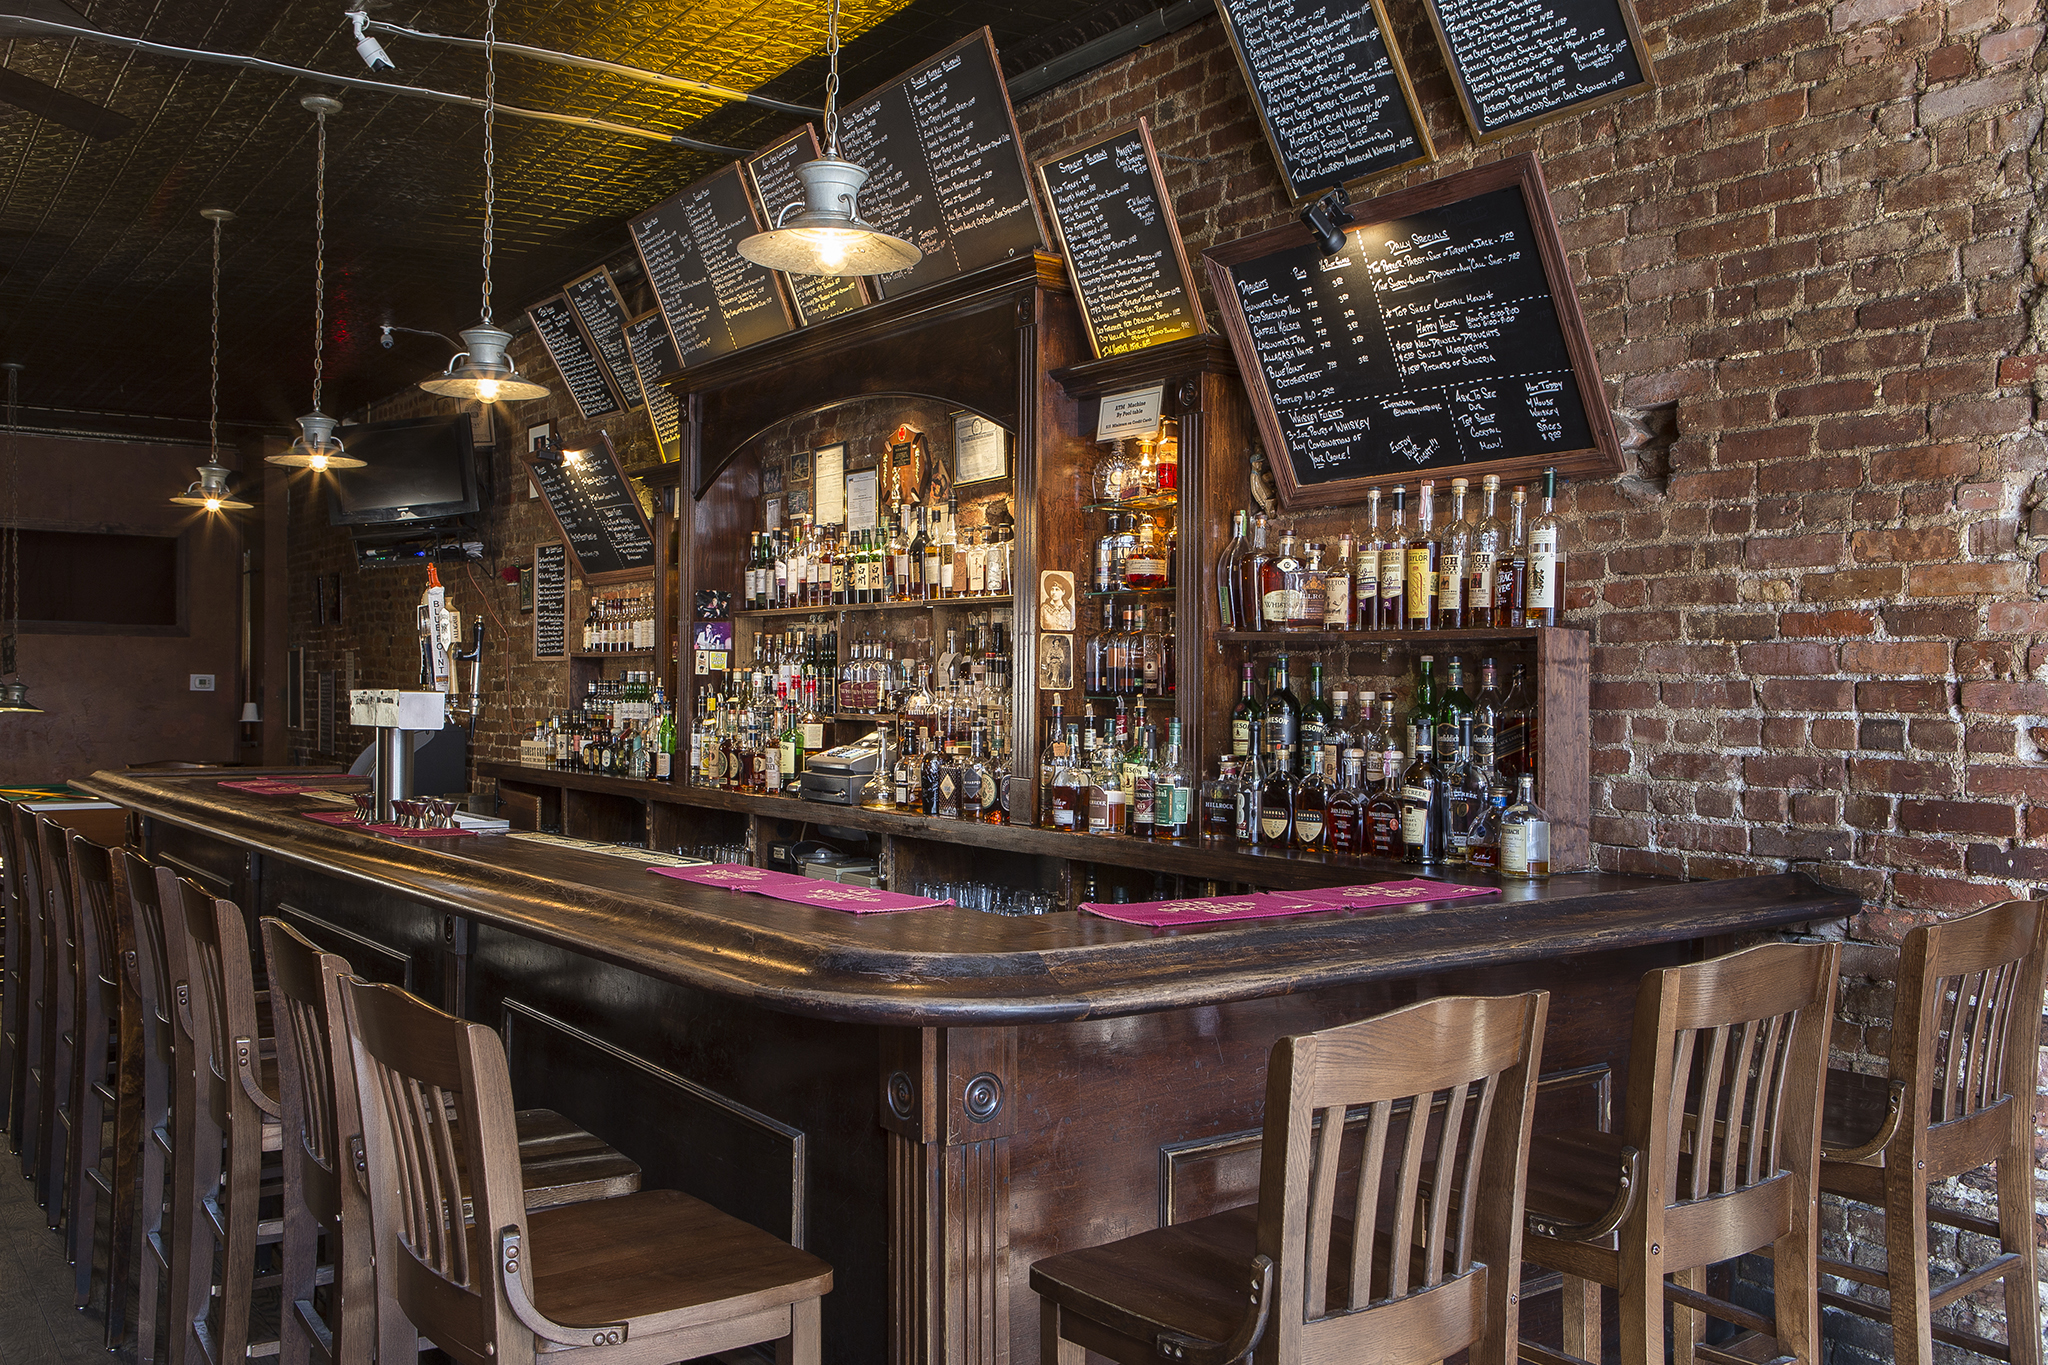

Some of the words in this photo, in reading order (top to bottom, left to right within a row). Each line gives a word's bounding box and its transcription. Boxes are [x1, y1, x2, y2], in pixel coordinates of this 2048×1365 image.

[1385, 239, 1413, 256] DAILY
[1411, 229, 1450, 249] SPECIALS
[1433, 296, 1466, 310] COCKTAIL
[1415, 321, 1438, 338] HAPPY
[1480, 386, 1497, 399] SEE
[1288, 411, 1319, 427] WHISKEY
[1333, 416, 1371, 433] WHISKEY
[1205, 801, 1234, 810] HILLROCK
